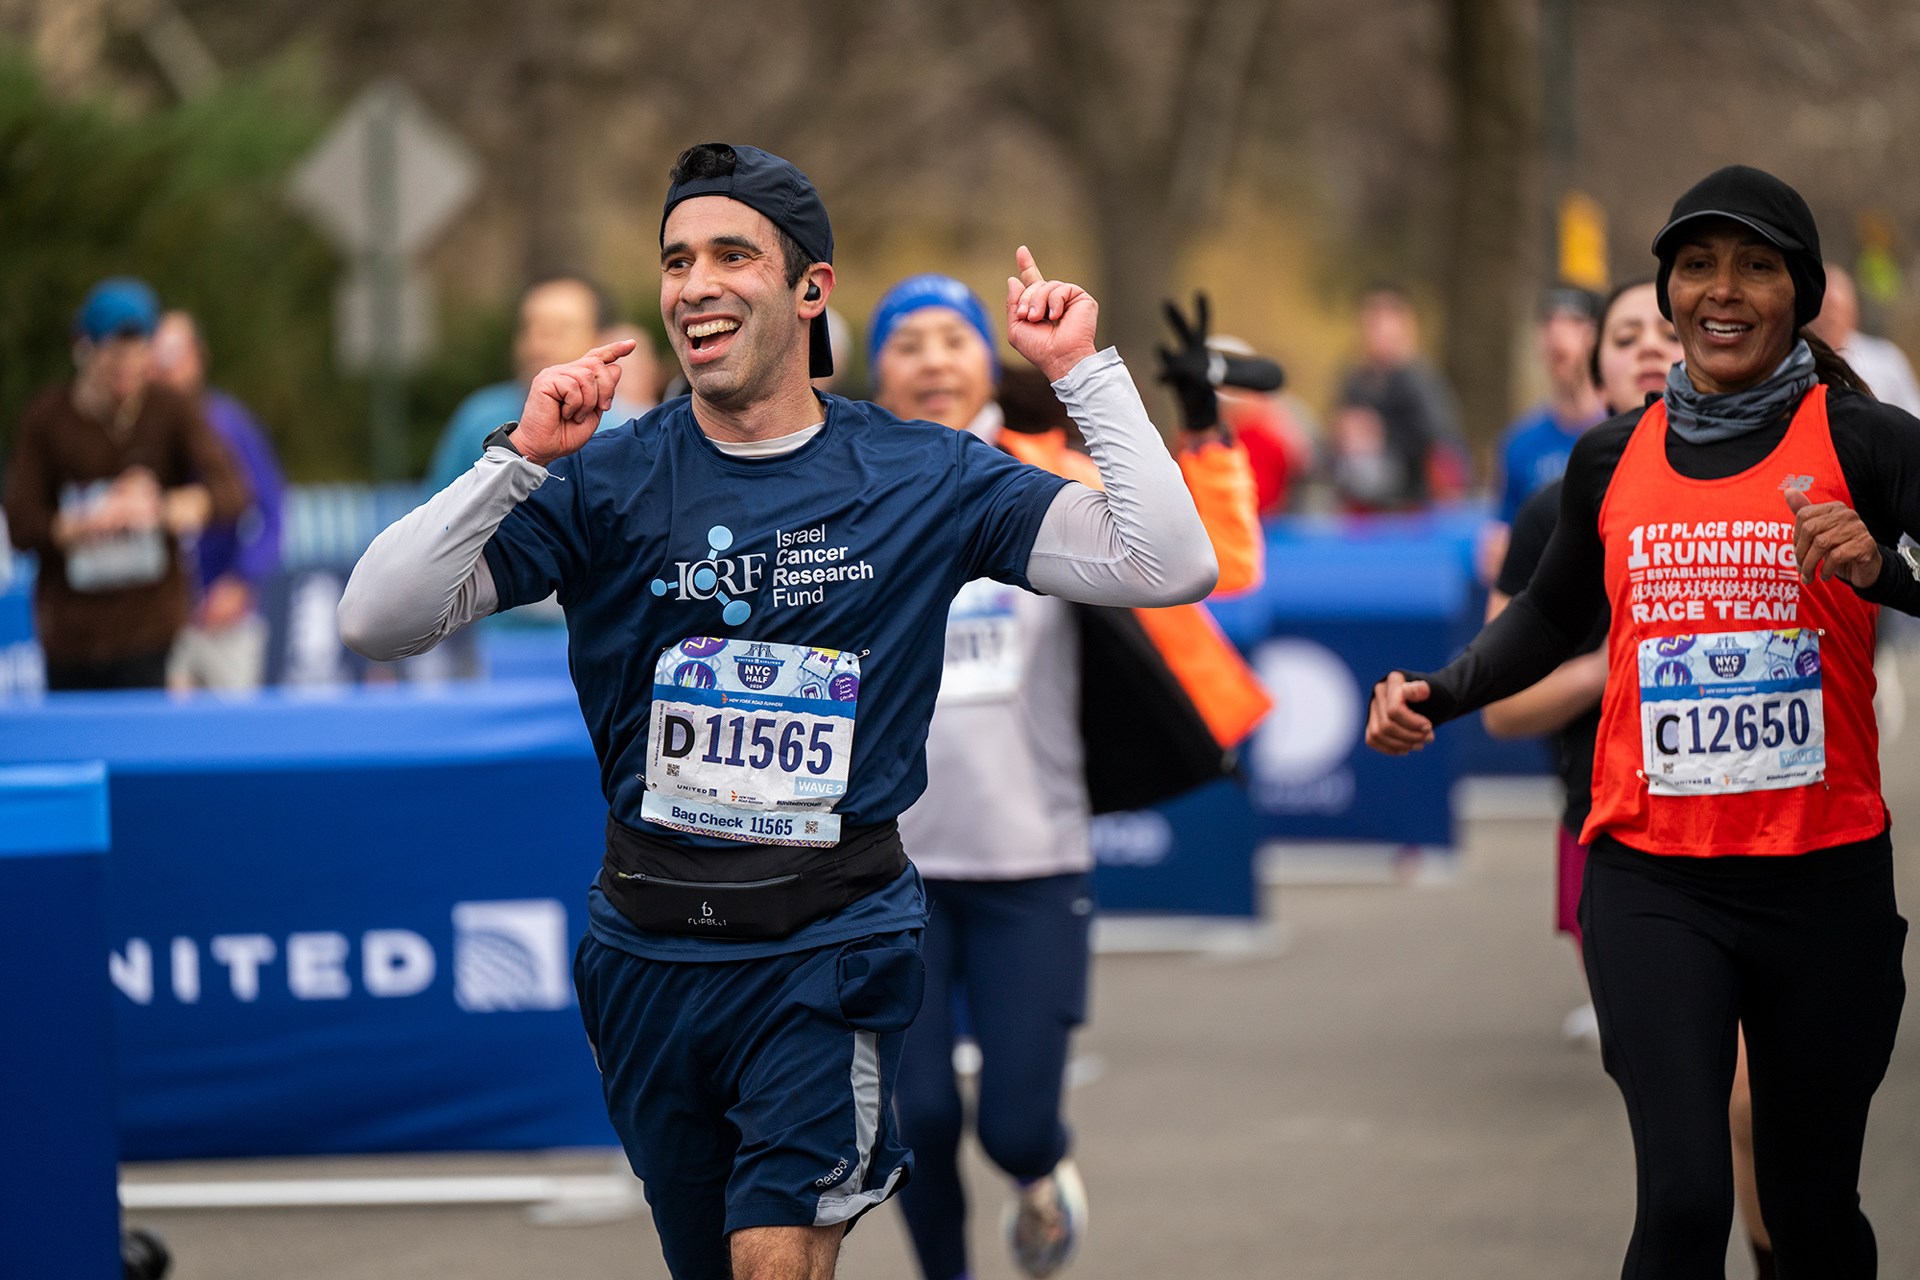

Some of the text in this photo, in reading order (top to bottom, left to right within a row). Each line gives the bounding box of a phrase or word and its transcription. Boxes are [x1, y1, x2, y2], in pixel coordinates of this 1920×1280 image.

[776, 523, 826, 548] Israel
[1671, 522, 1727, 539] PLACE
[1732, 521, 1796, 541] SPORT
[776, 546, 849, 567] Cancer
[1653, 540, 1799, 568] RUNNING
[675, 552, 767, 601] ICRF
[772, 560, 874, 587] Research
[1646, 566, 1739, 581] ESTABLISHED
[772, 585, 824, 608] Fund
[1631, 600, 1798, 625] RACE TEAM
[744, 665, 771, 676] NYC
[1715, 655, 1740, 668] NYC
[745, 675, 768, 684] HALF
[1655, 714, 1681, 756] C
[1686, 698, 1811, 755] 12650
[662, 714, 696, 759] D
[701, 713, 835, 776] 11565
[1782, 751, 1814, 764] WAVE
[677, 784, 708, 794] UNITED
[798, 781, 844, 795] WAVE 2
[671, 806, 793, 836] Bag Check 11565
[108, 930, 437, 1005] NITED
